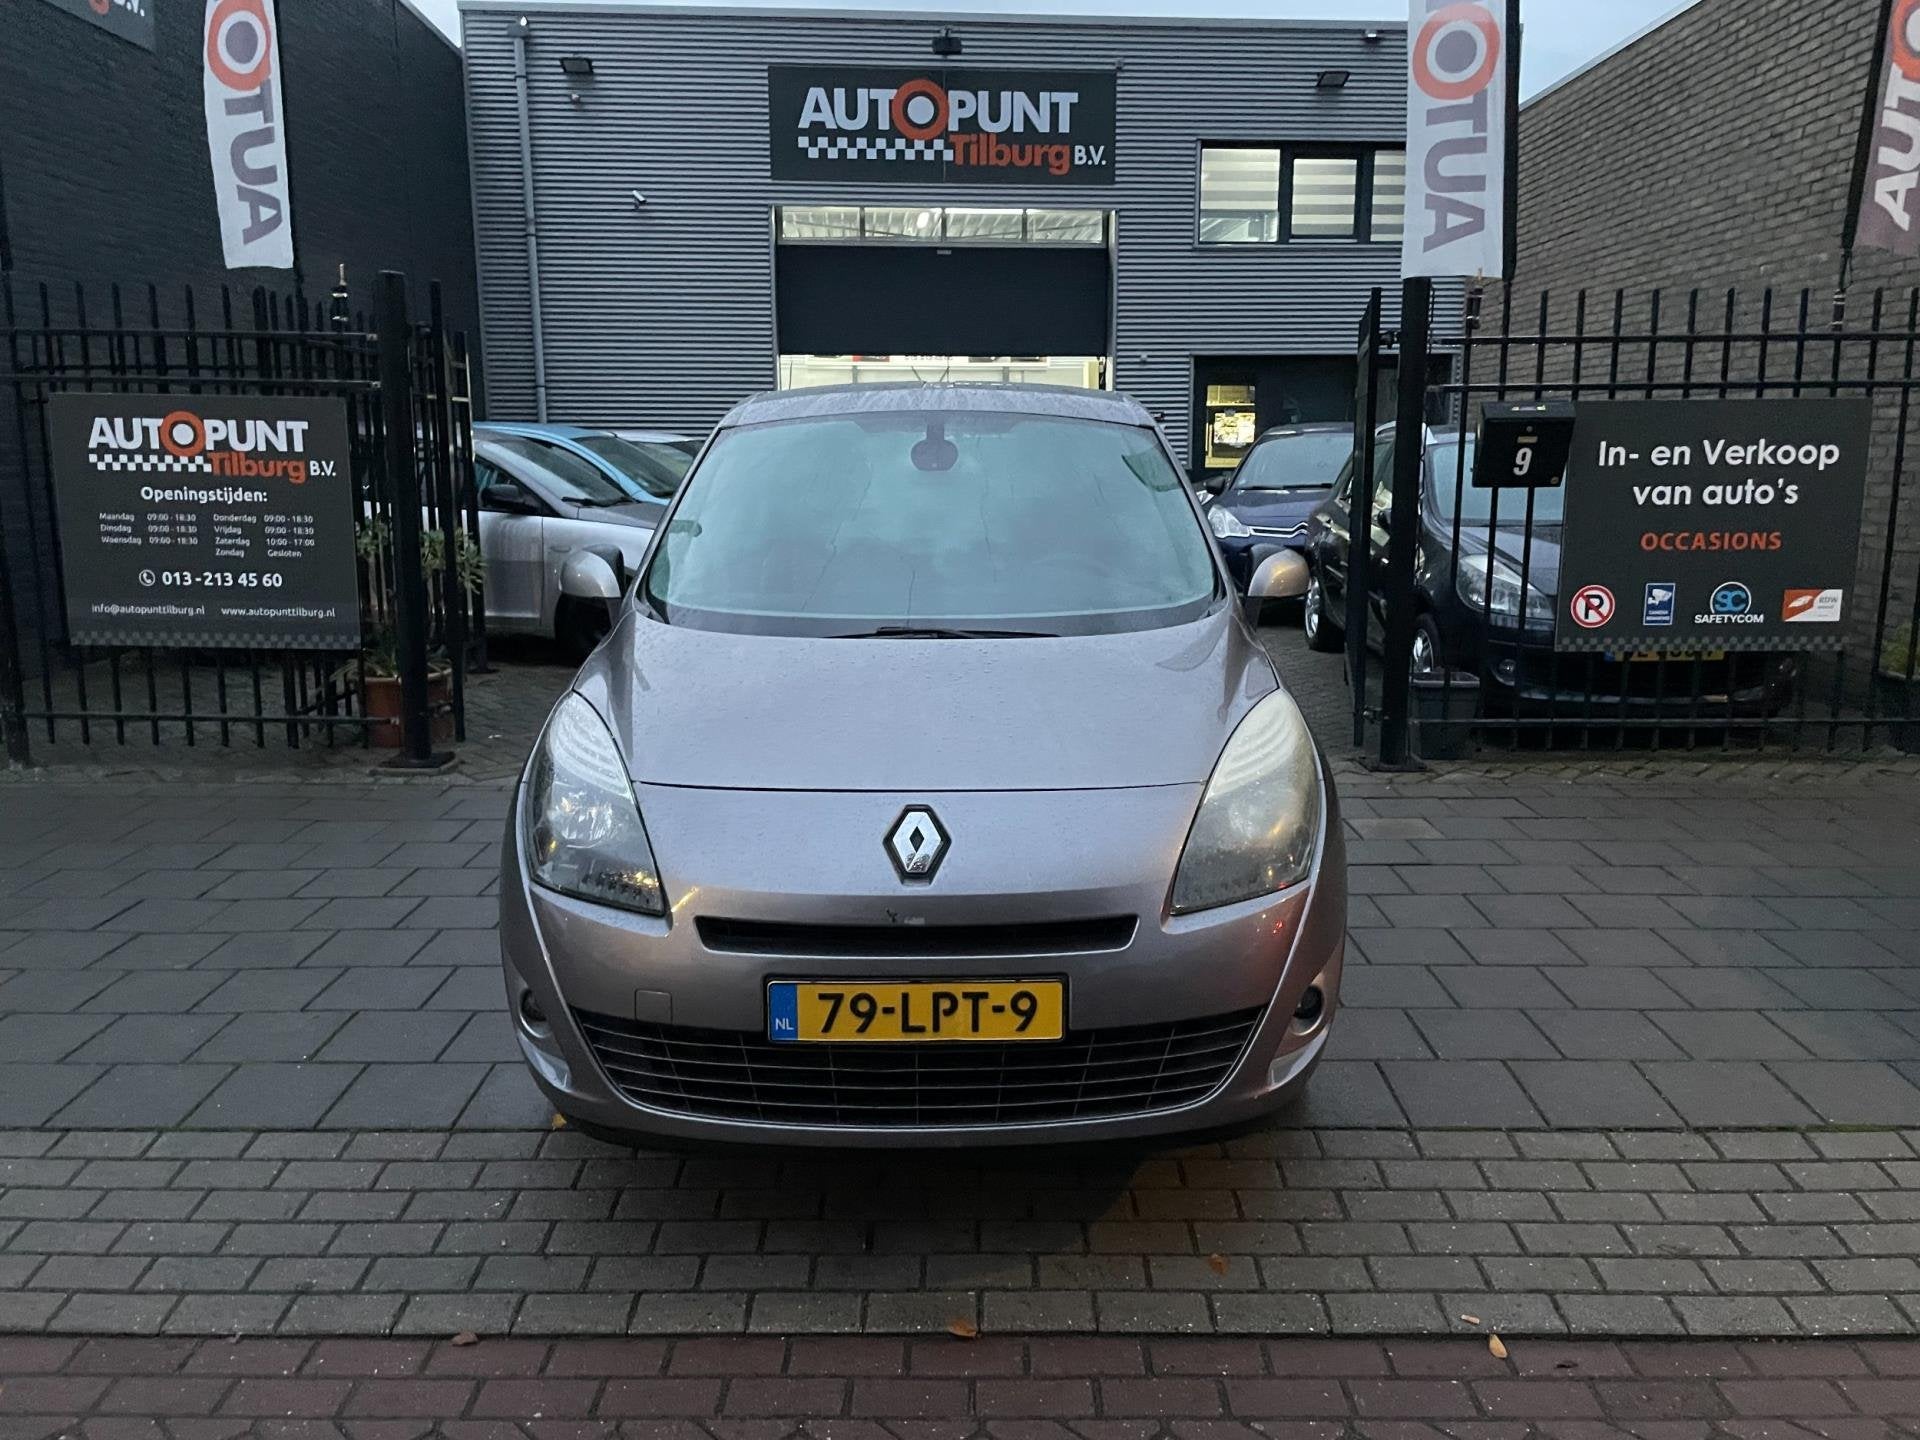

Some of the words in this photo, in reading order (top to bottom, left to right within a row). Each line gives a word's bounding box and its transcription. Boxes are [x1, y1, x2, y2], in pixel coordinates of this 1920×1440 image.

[797, 79, 1079, 141] AUTOPUNT
[950, 133, 1070, 176] Tilburg
[1074, 145, 1107, 165] B.V.
[88, 410, 309, 457] AUTOPUNT
[1512, 447, 1533, 476] 9
[1598, 440, 1639, 467] In-
[1650, 446, 1692, 467] en
[1703, 438, 1840, 470] Verkoop
[207, 451, 306, 484] Tilburg
[309, 460, 337, 477] B.V.
[140, 486, 268, 504] Openingstijden:
[1633, 484, 1692, 505] van
[1702, 478, 1799, 505] auto's
[99, 512, 135, 522] Maandag
[213, 513, 257, 524] Donderdag
[213, 525, 242, 535] Vrijdag
[1640, 531, 1783, 551] OCCASIONS
[215, 547, 245, 559] Zondag
[267, 548, 302, 558] Gesloten
[237, 572, 258, 587] 45
[262, 573, 283, 587] 60
[91, 603, 206, 616] info@autopunttilburg.nl
[221, 606, 336, 619] www.autopunttilburg.nl
[1694, 614, 1764, 624] SAFETYCOM
[818, 990, 1038, 1033] 79-LPT-9
[775, 1017, 794, 1030] NL
